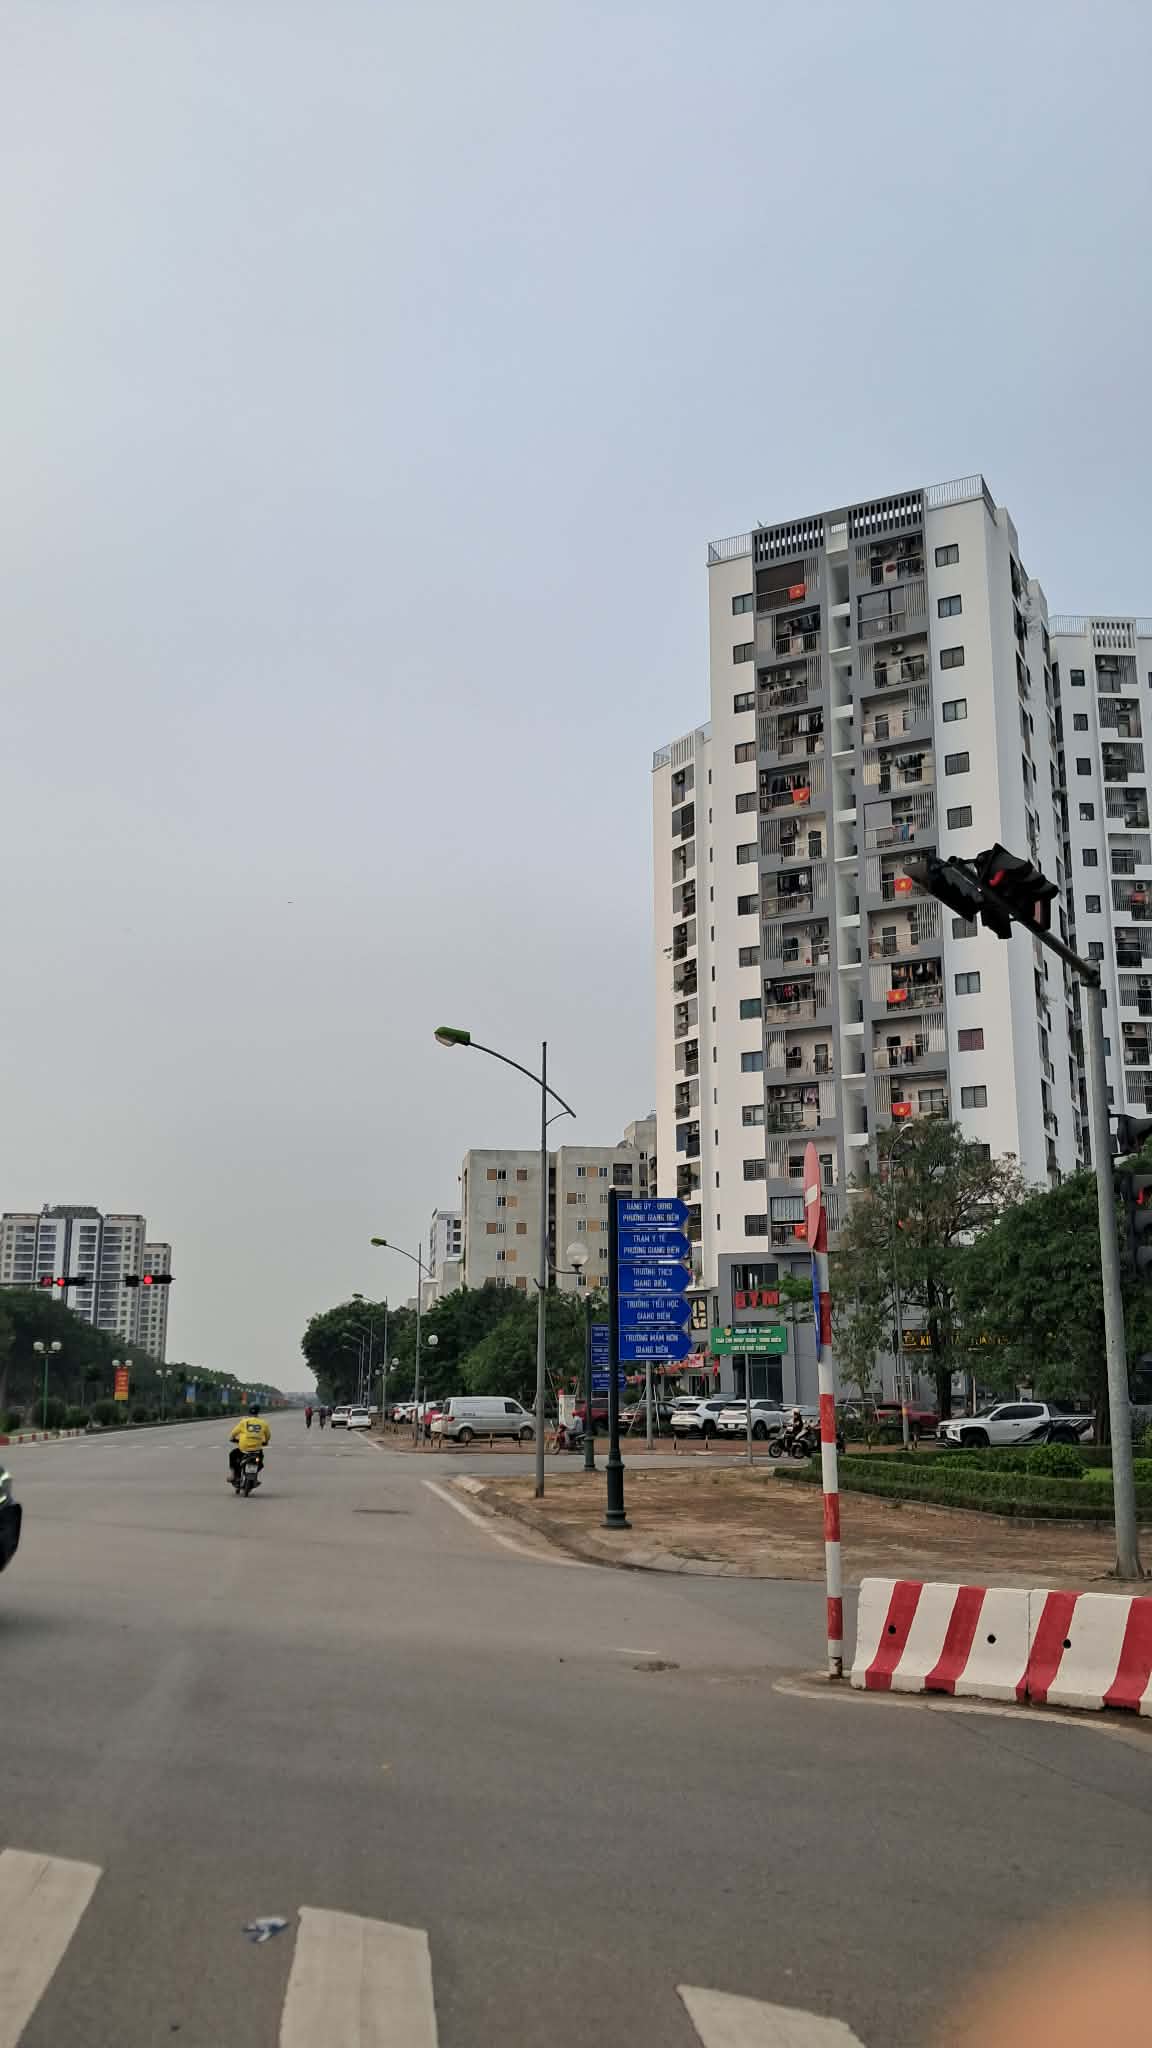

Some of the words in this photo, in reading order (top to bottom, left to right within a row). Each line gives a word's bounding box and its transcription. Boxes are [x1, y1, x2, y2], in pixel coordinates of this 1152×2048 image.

[651, 1234, 657, 1243] Y
[658, 1268, 673, 1276] THCS
[246, 1421, 262, 1432] be
